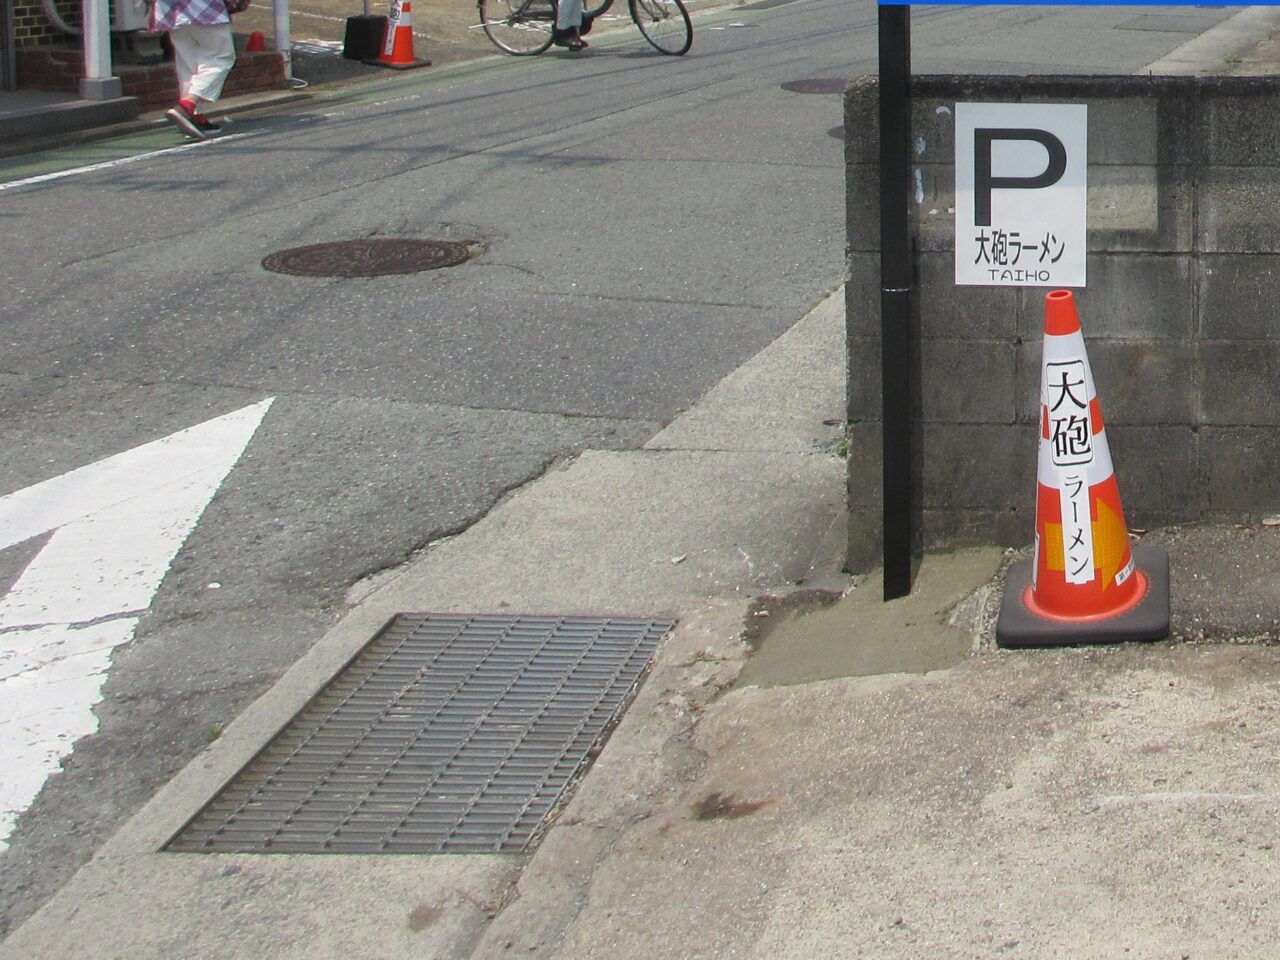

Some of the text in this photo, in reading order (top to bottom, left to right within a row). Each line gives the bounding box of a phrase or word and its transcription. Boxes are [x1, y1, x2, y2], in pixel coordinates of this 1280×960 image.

[974, 127, 1067, 227] P
[974, 228, 1066, 266] 大砲ラーメン
[987, 269, 1050, 282] TAIHO
[1048, 371, 1092, 577] 大砲 ラーメン
